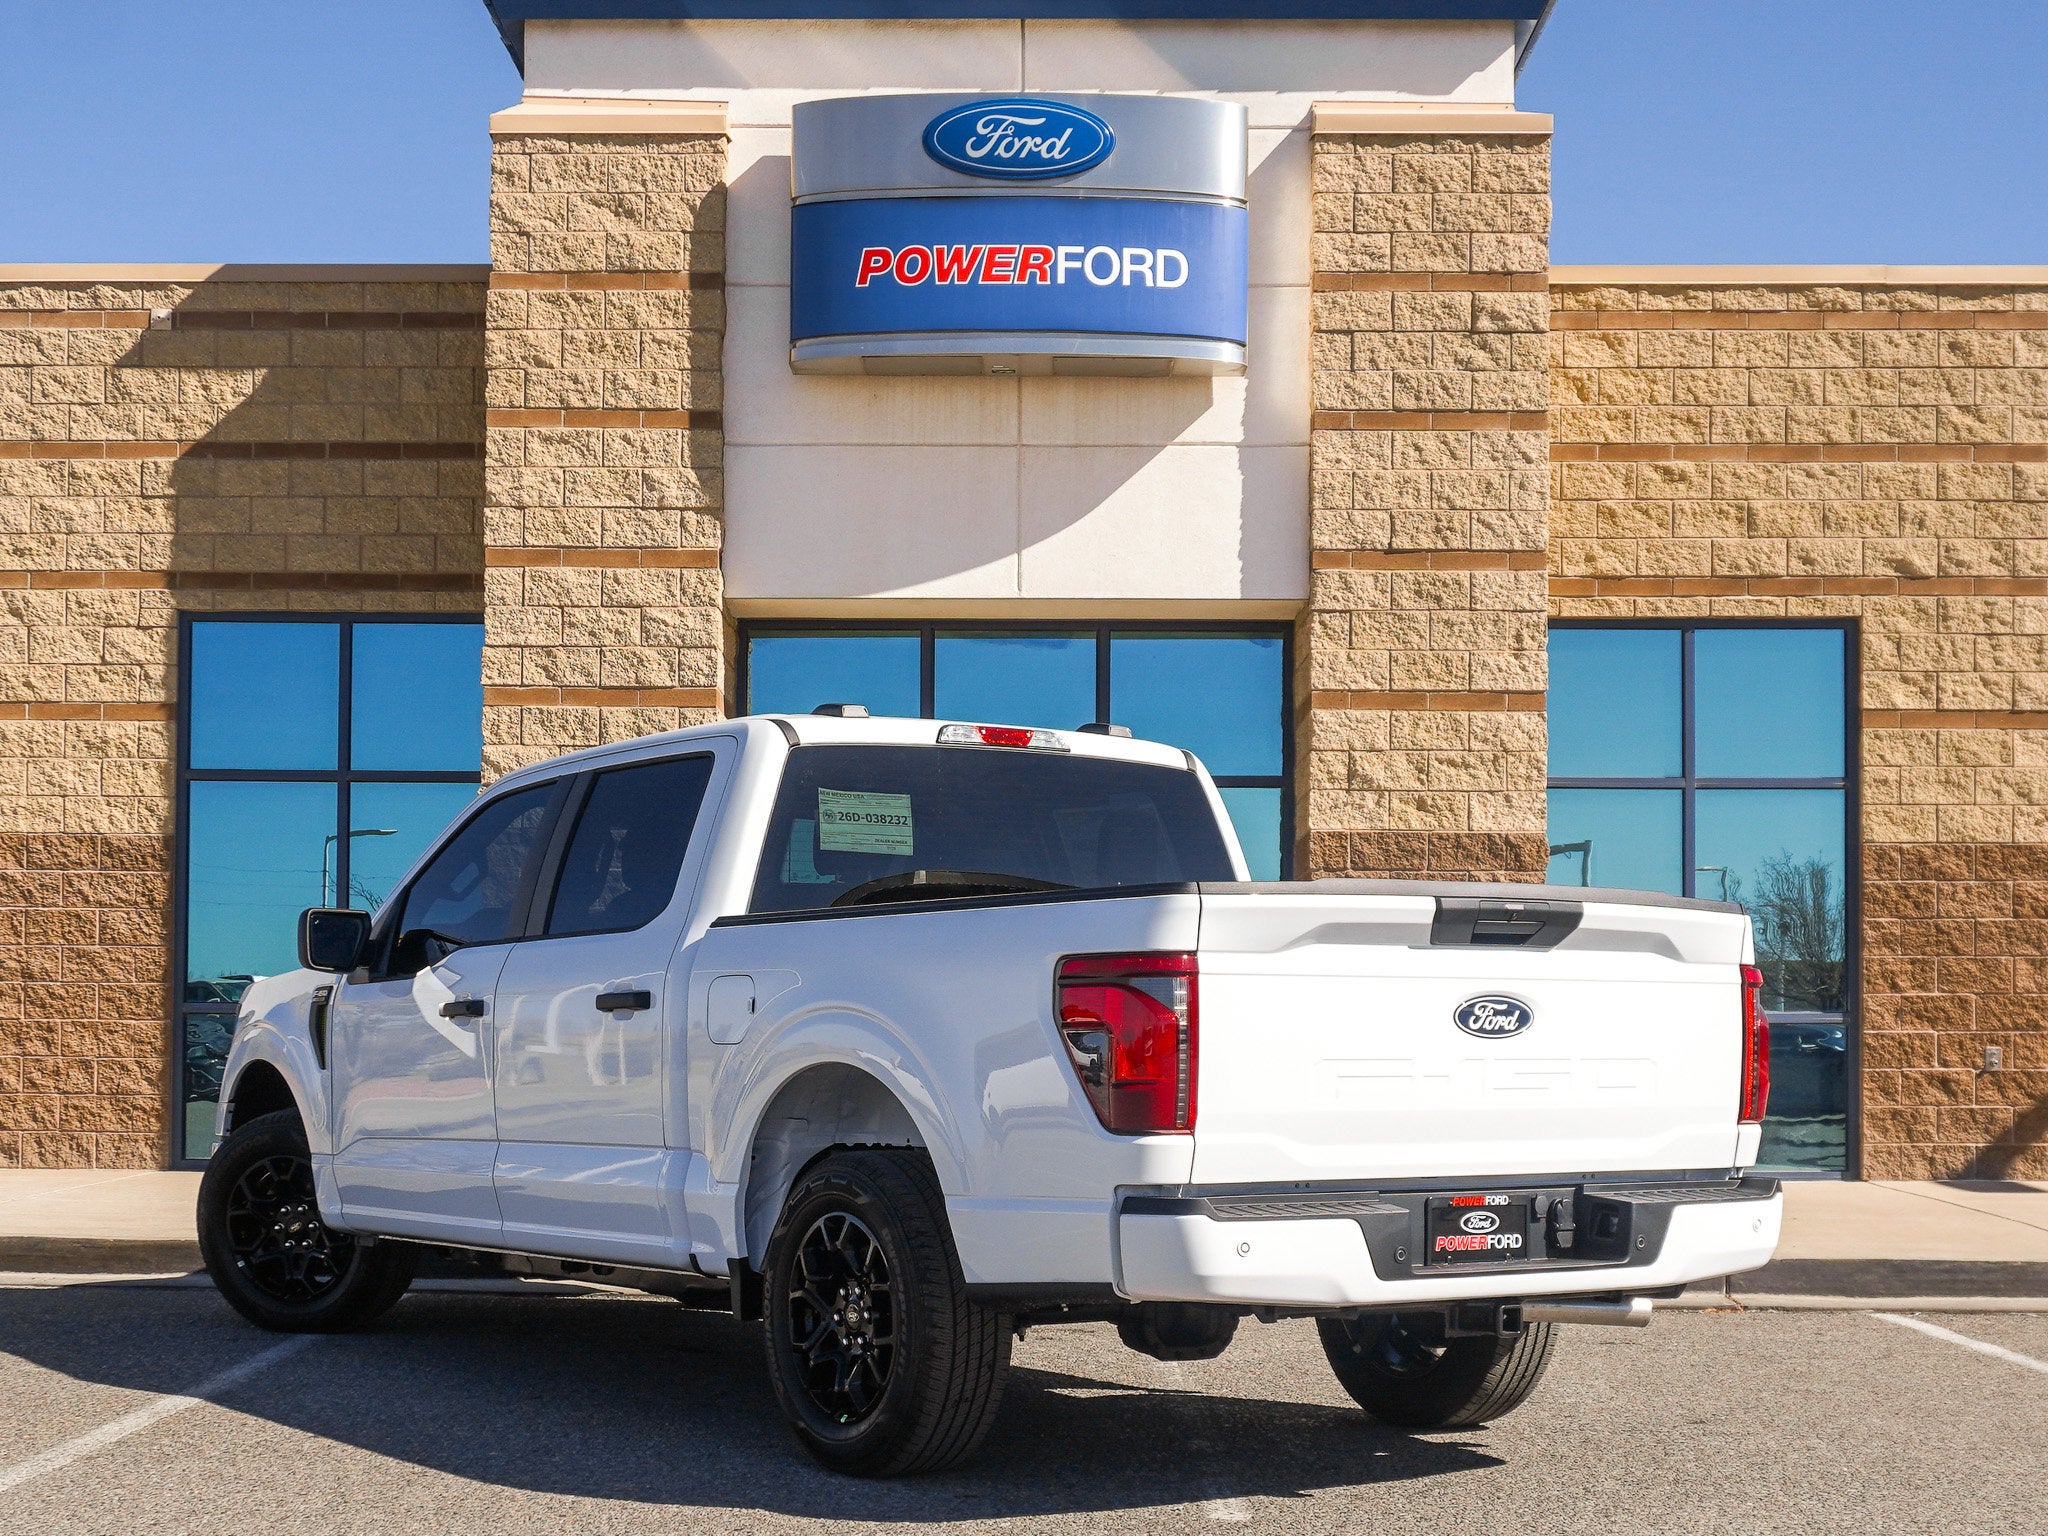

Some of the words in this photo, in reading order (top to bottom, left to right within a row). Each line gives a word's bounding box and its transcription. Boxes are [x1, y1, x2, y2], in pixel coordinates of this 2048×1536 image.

[965, 114, 1073, 160] Ford
[837, 811, 909, 826] 26D-038232
[1468, 1002, 1519, 1032] Ford
[1467, 1215, 1492, 1229] Ford
